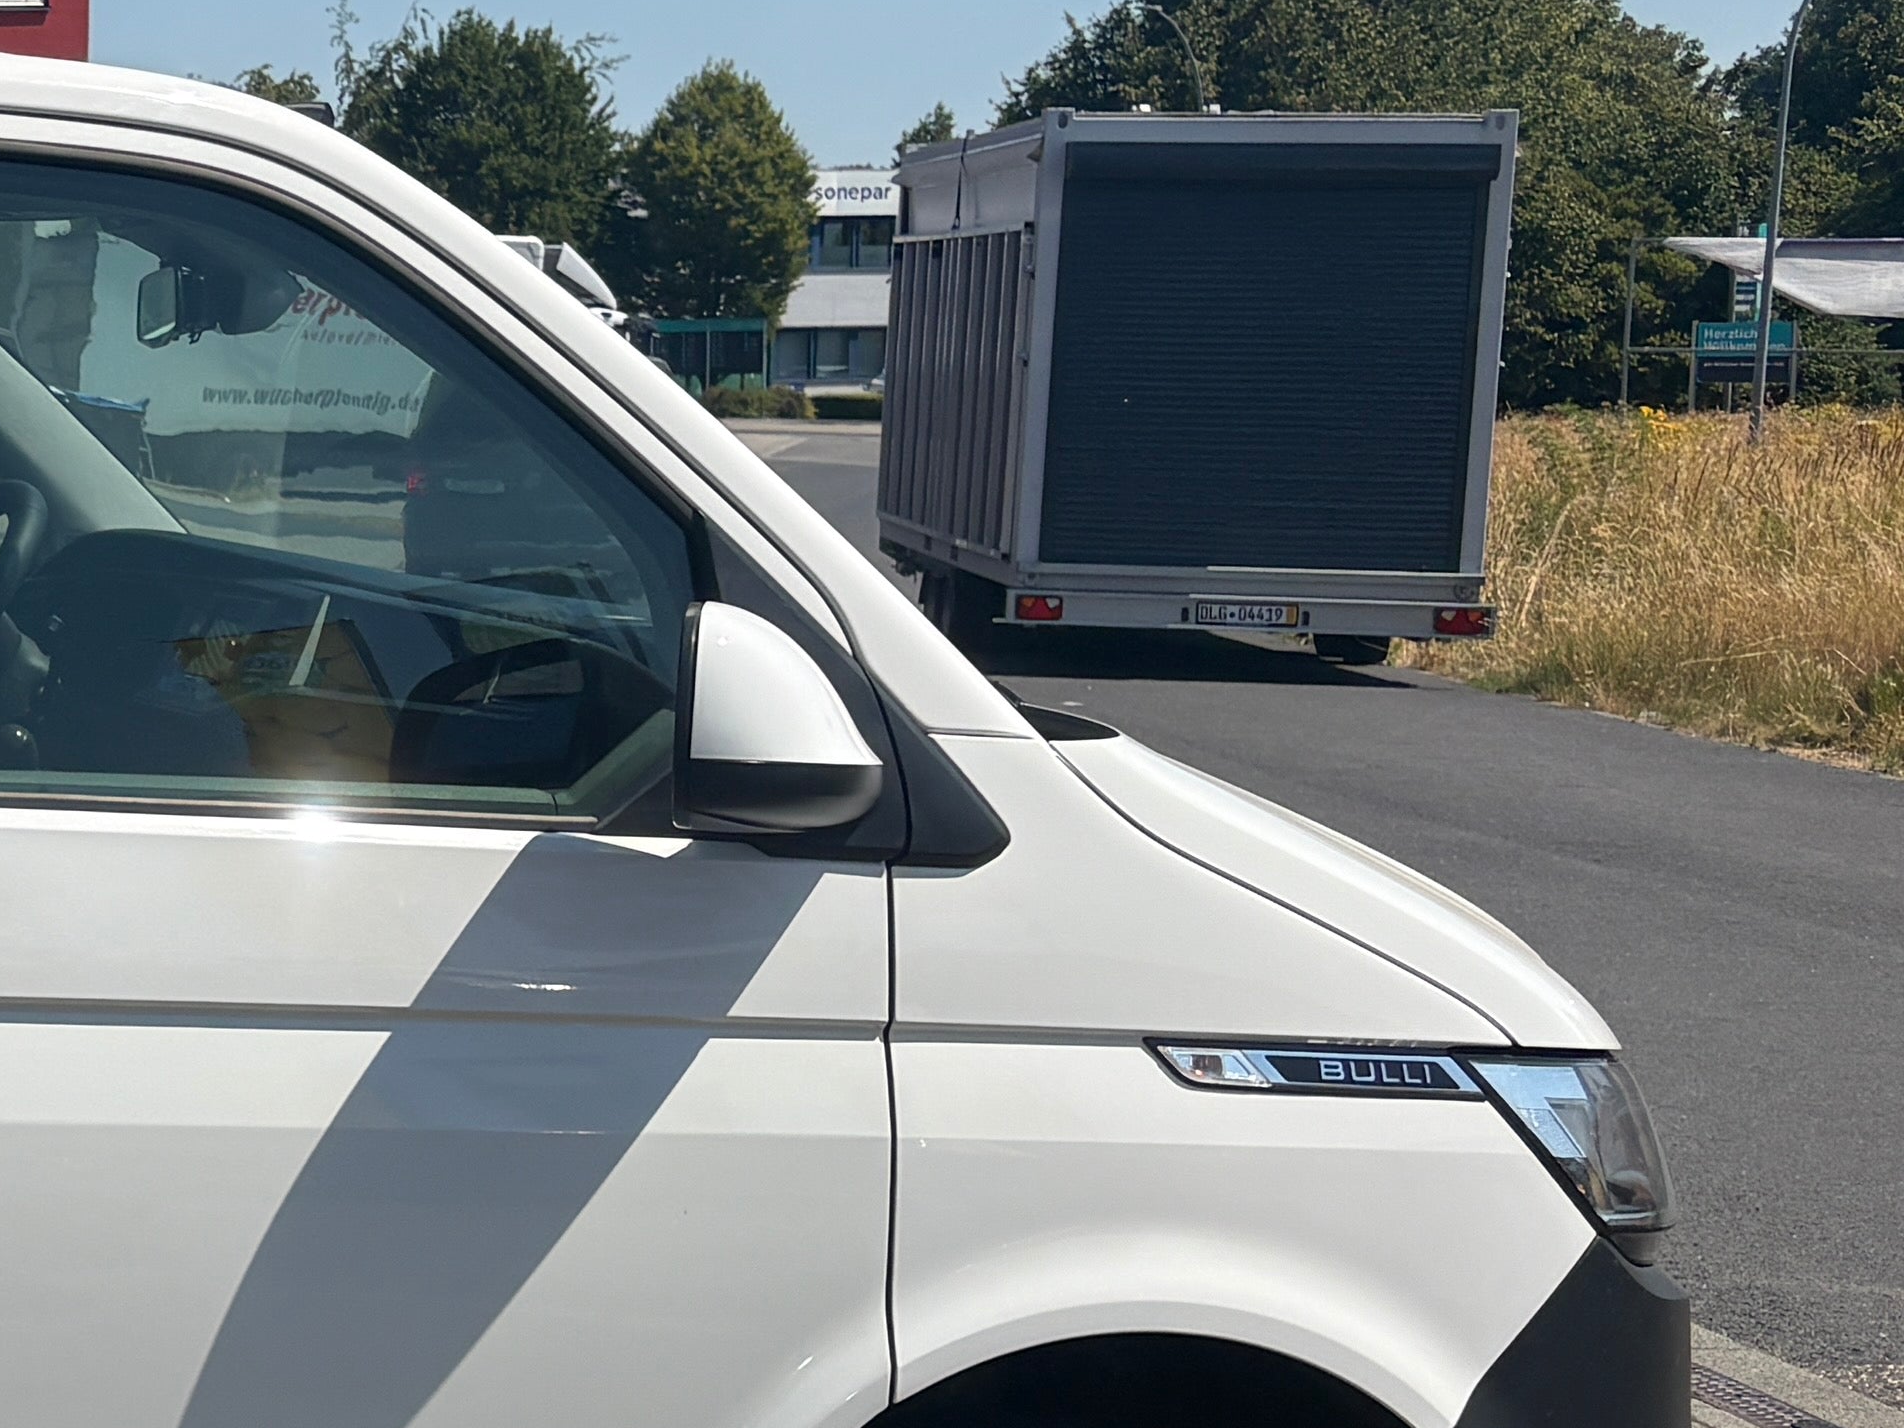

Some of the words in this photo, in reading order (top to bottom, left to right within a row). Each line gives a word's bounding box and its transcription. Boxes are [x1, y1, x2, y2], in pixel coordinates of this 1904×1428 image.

[814, 186, 892, 203] sonepar
[1703, 327, 1758, 340] Herzlich
[1318, 1059, 1432, 1084] BULLI
